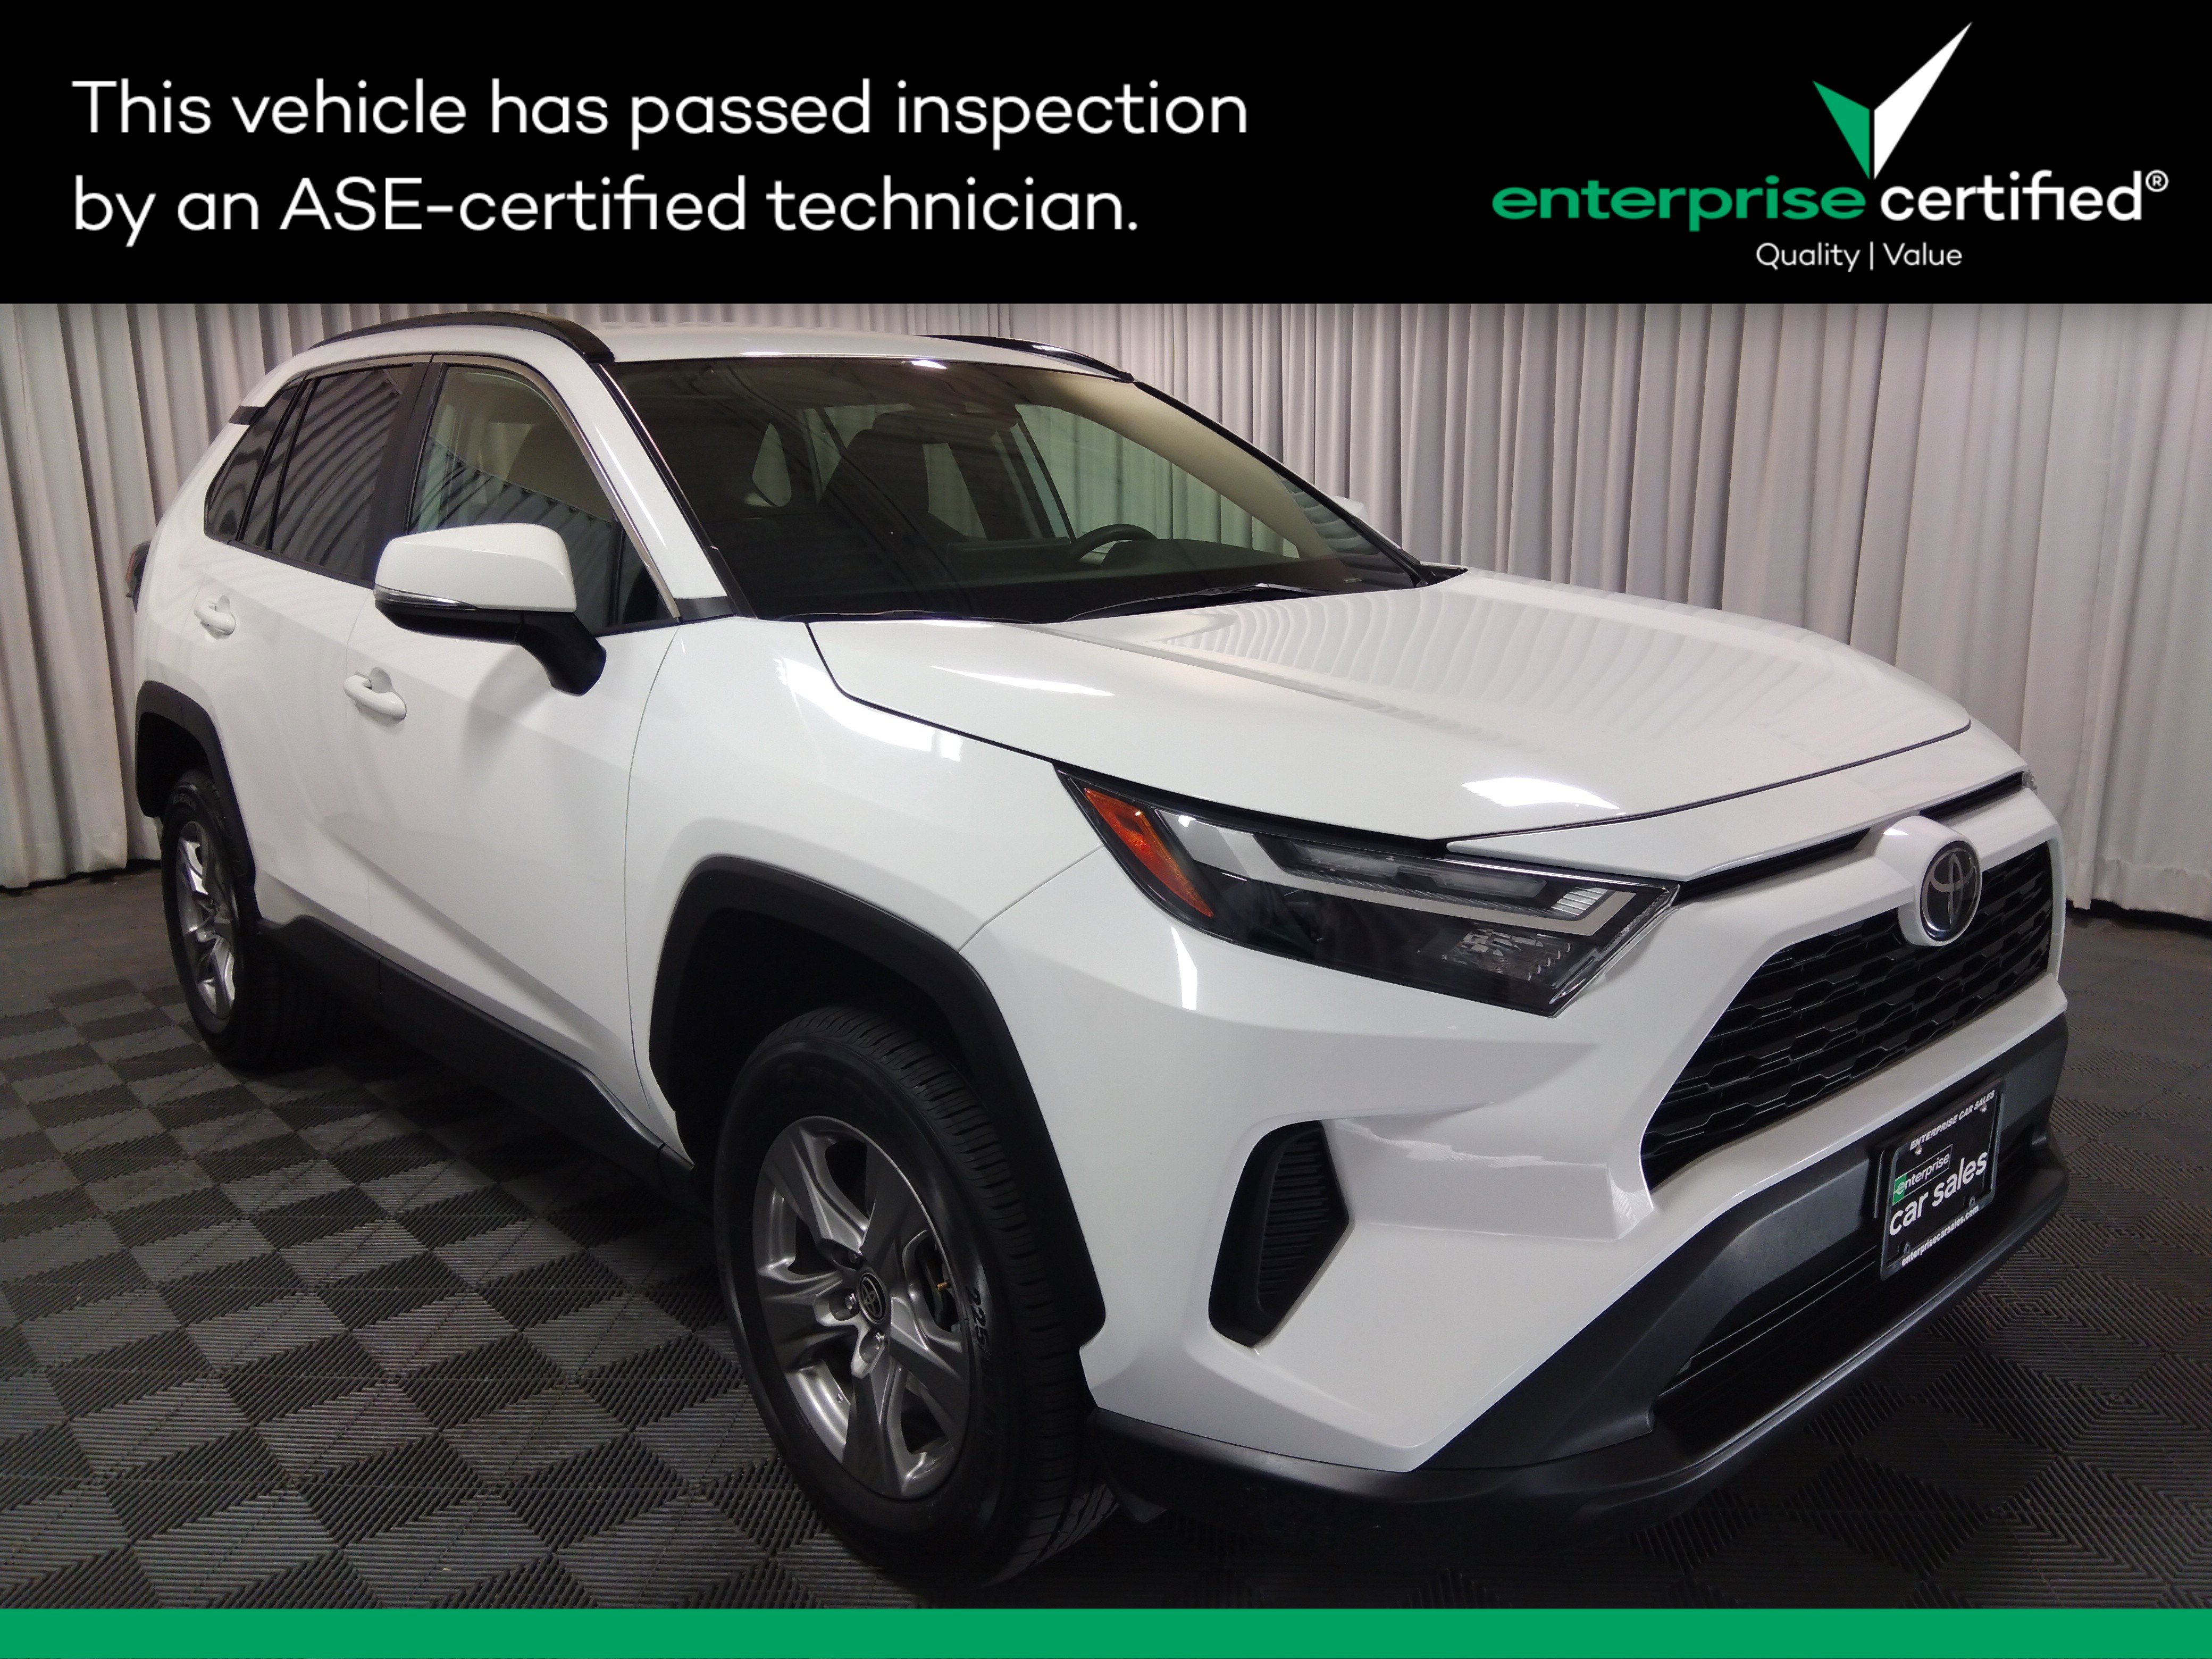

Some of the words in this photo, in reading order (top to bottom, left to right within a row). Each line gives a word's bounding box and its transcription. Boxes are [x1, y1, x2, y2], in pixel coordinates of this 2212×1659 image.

[1909, 1114, 1957, 1151] ENTERPRISE
[1958, 1104, 1974, 1120] CAR
[1974, 1090, 1995, 1110] SALES
[1889, 1192, 1929, 1236] car
[1932, 1152, 1988, 1207] sales
[1894, 1154, 1950, 1195] enterprise
